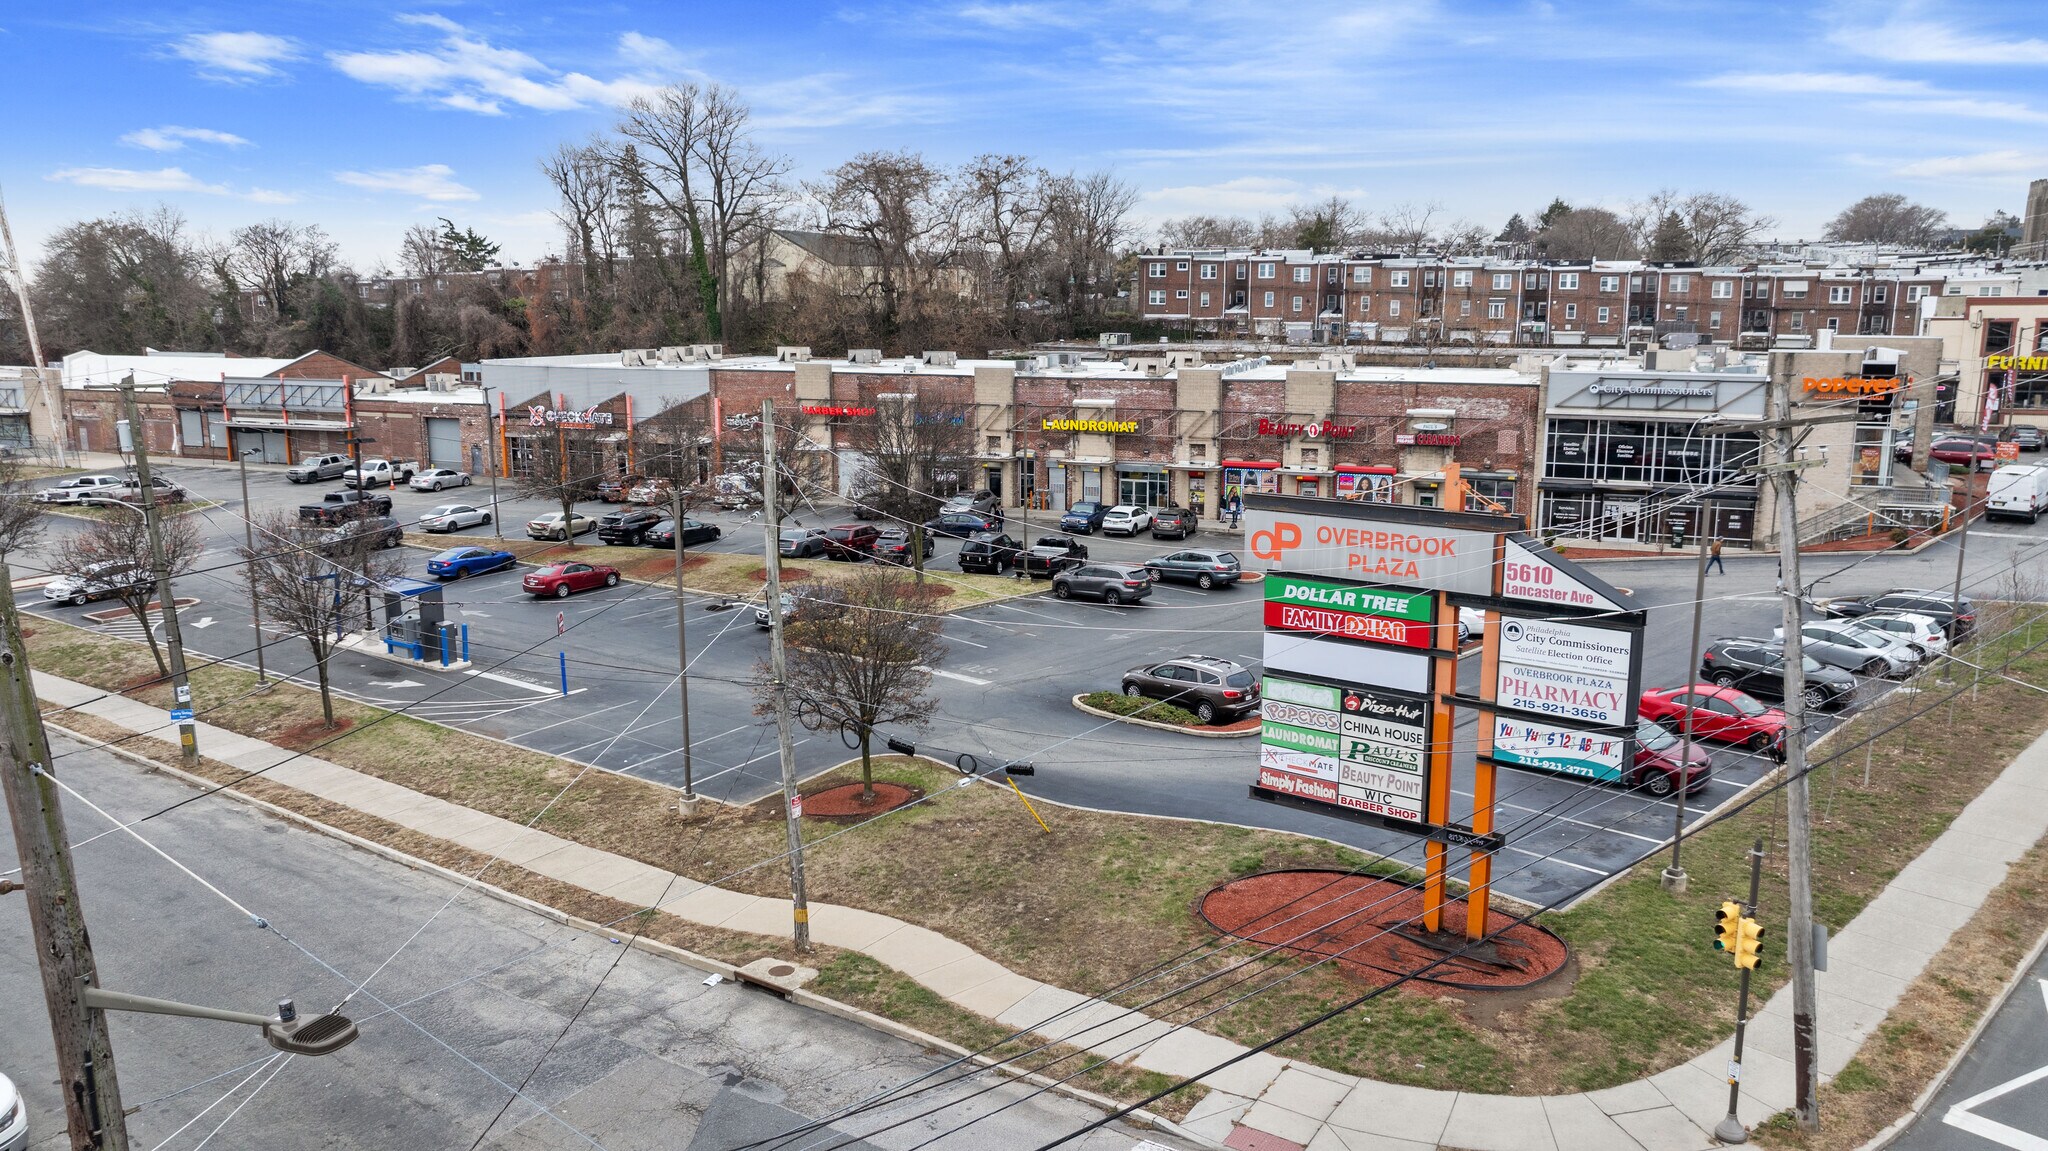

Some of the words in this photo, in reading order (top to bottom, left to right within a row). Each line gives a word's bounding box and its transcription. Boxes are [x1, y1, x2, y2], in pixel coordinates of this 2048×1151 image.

[1603, 384, 1624, 395] City
[1629, 384, 1713, 396] Commissioners
[1042, 419, 1137, 433] LAUNDROMAT
[1417, 433, 1461, 446] CLEANERS
[1316, 525, 1457, 558] OVERBROOK
[1348, 553, 1420, 578] PLAZA
[1506, 562, 1553, 585] 5610
[1283, 584, 1357, 606] DOLLAR
[1361, 594, 1409, 613] TREE
[1505, 582, 1568, 601] Lancaster
[1570, 590, 1594, 604] Ave
[1282, 606, 1343, 633] FAMILY
[1344, 615, 1406, 642] DOLLAR
[1526, 625, 1571, 638] Philadelphia
[1515, 645, 1547, 656] Satellite
[1547, 649, 1583, 661] Election
[1585, 654, 1613, 665] Office
[1525, 633, 1546, 645] City
[1548, 636, 1630, 656] Commissioners
[1513, 667, 1574, 684] OVERBROOK
[1576, 676, 1613, 690] PLAZA
[1501, 675, 1624, 711] PHARMACY
[1360, 697, 1394, 714] Pizza
[1395, 704, 1422, 719] Hut
[1512, 698, 1608, 721] 215-921-3656
[1262, 725, 1339, 751] LAUNDROMAT
[1343, 720, 1381, 737] CHINA
[1384, 727, 1423, 744] HOUSE
[1347, 740, 1418, 763] PAUL'S
[1364, 755, 1389, 765] DISCOUNT
[1389, 760, 1417, 771] CLEANERS
[1518, 755, 1595, 777] 215-921-3771
[1261, 771, 1295, 792] Simply
[1296, 778, 1336, 799] Fashion
[1341, 765, 1384, 787] BEAUTY
[1386, 774, 1420, 794] POINT
[1340, 796, 1383, 813] BARBER
[1387, 807, 1418, 820] SHOP
[1364, 789, 1393, 805] WIC
